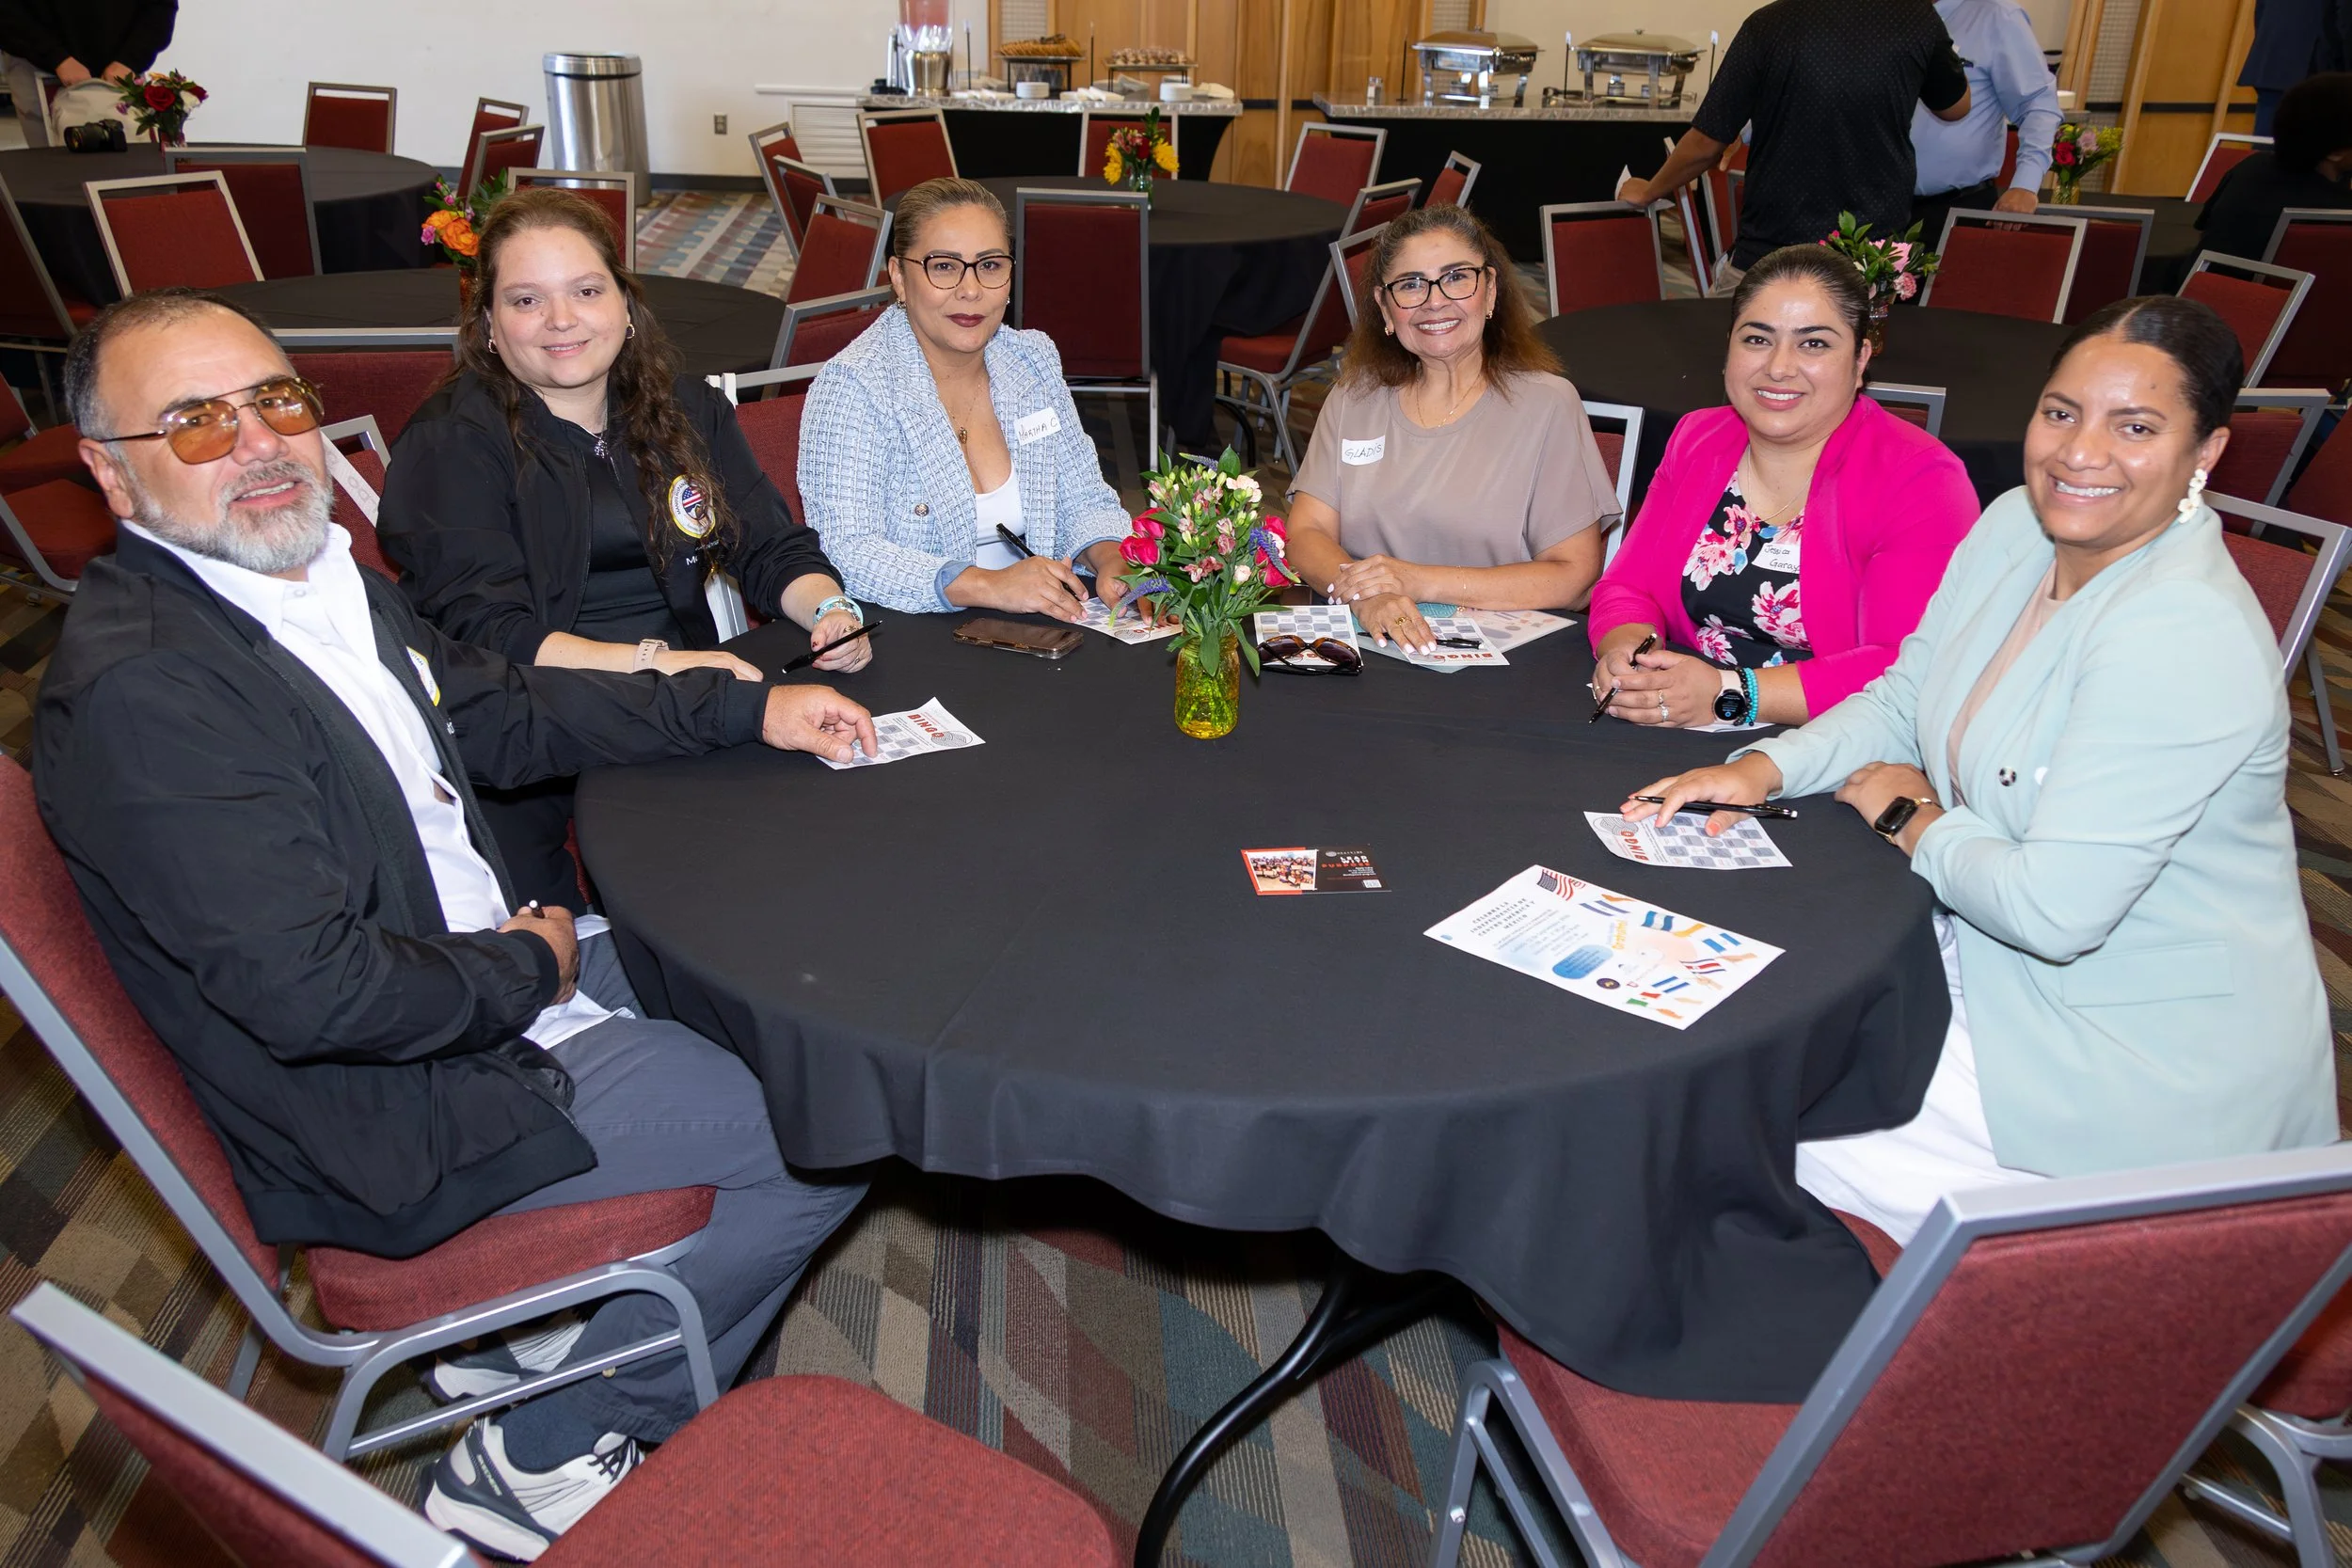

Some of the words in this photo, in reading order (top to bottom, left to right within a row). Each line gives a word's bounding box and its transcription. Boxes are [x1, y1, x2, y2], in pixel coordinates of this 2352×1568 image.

[1051, 417, 1057, 427] C
[907, 714, 945, 738] BINGO
[1620, 831, 1649, 861] BINGO
